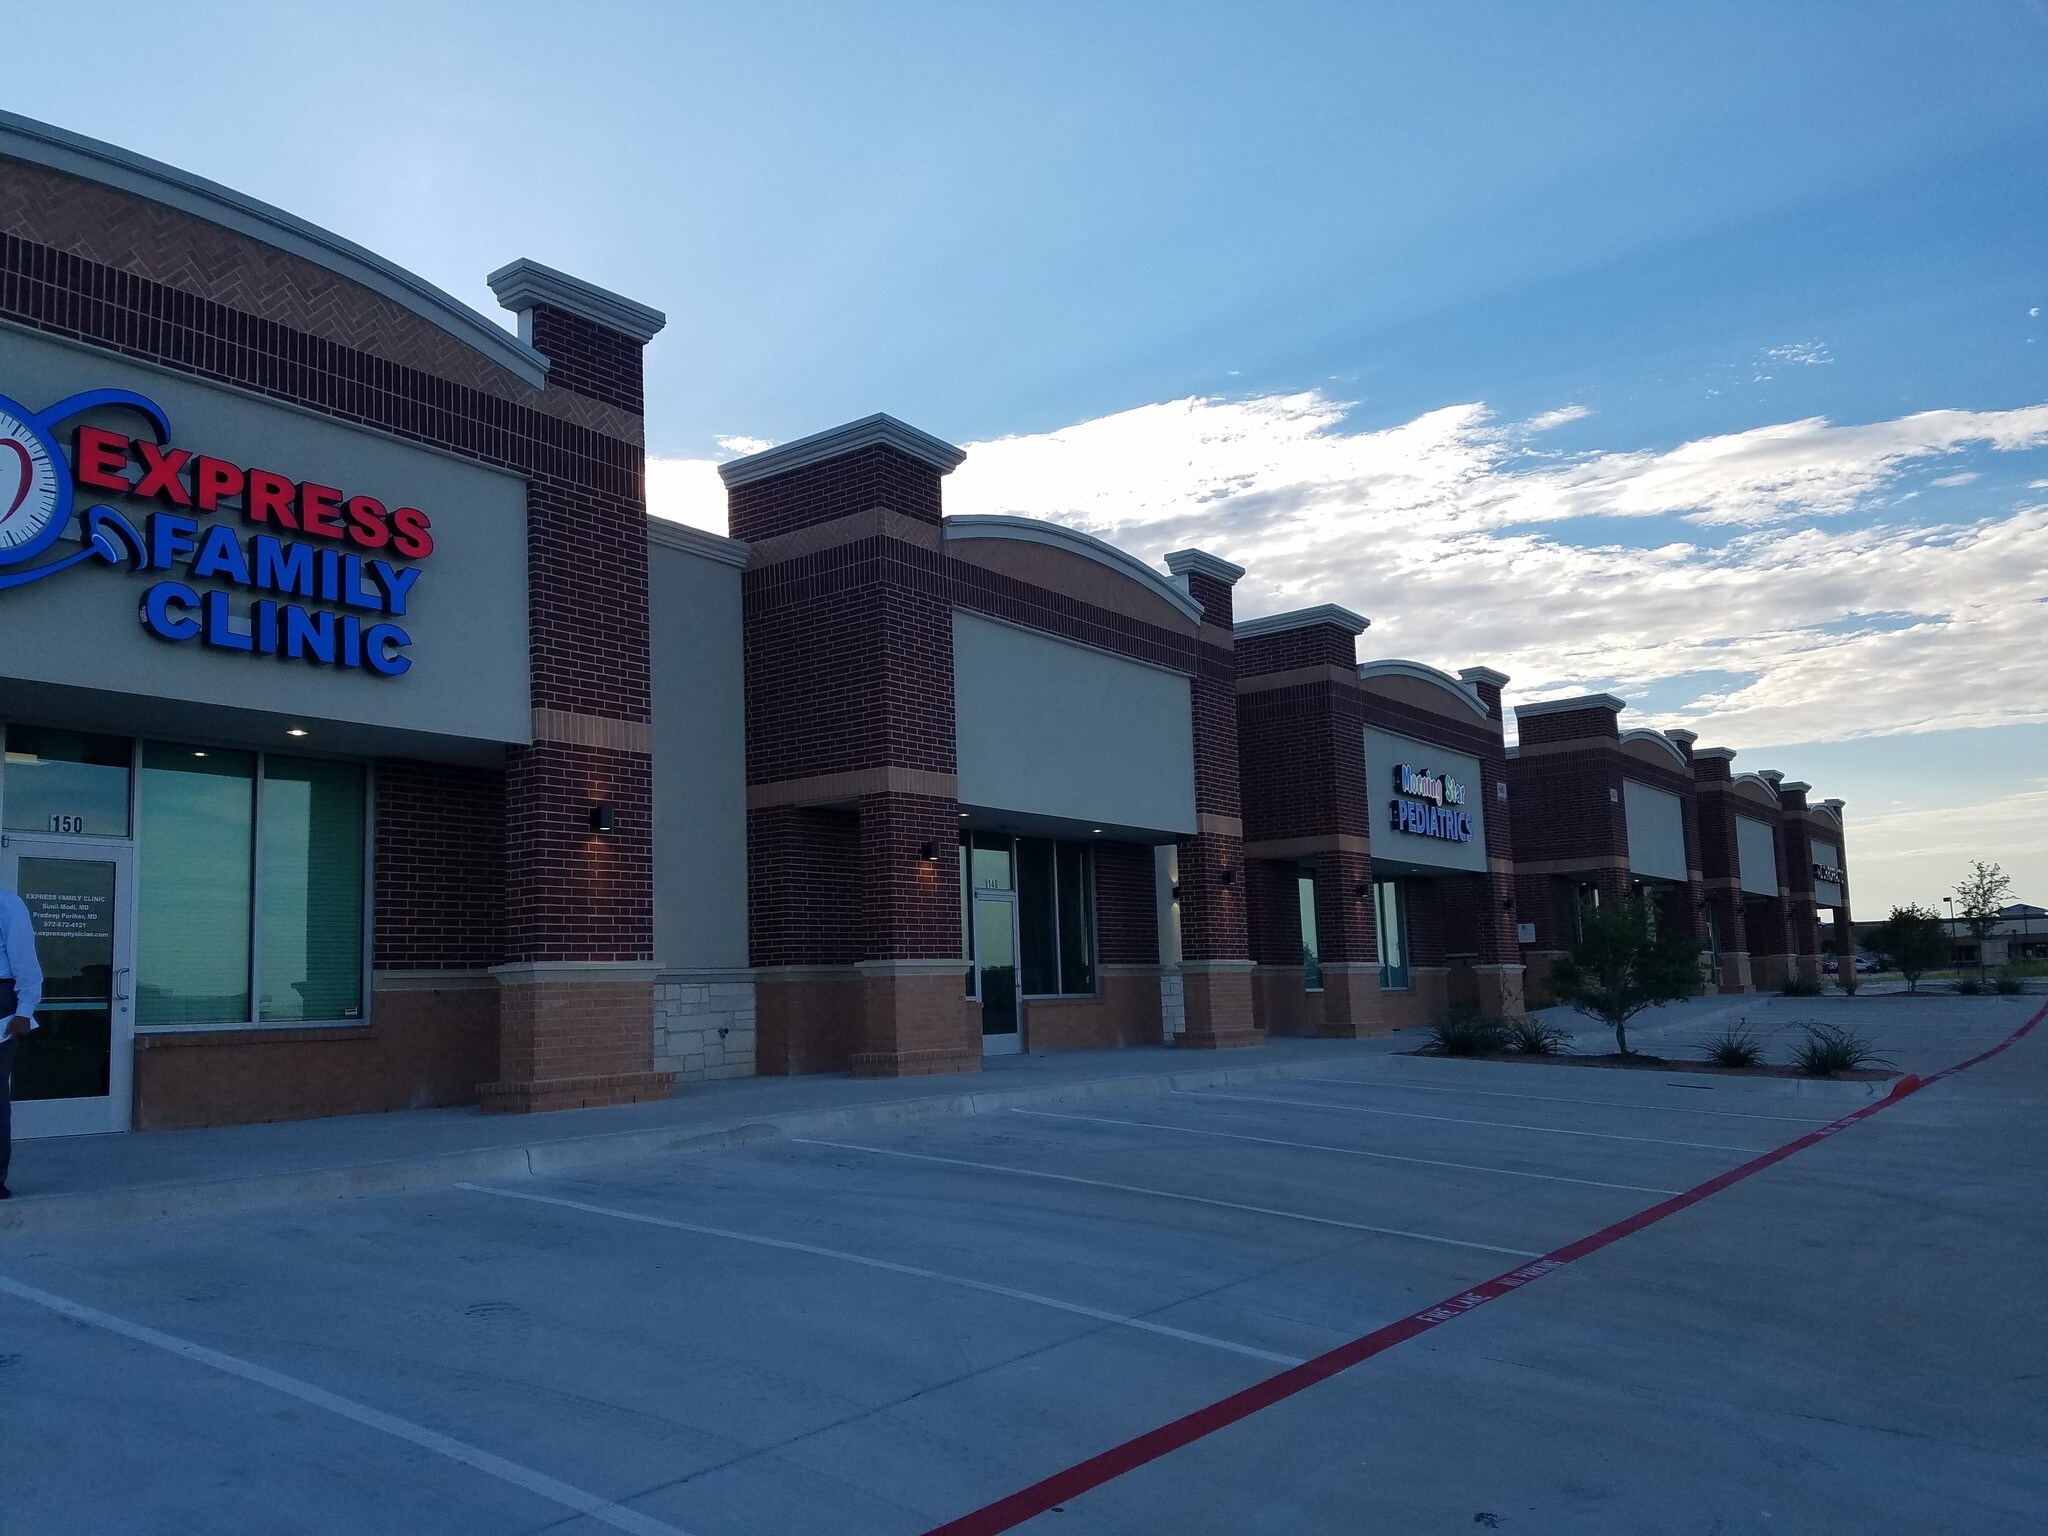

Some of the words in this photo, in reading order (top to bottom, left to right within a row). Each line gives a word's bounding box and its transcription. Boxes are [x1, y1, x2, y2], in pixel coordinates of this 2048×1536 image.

[75, 425, 433, 558] EXPRESS
[150, 513, 422, 616] FAMILY
[142, 581, 413, 676] CLINIC
[1401, 764, 1443, 806] Morning
[1444, 774, 1467, 805] Star
[52, 815, 83, 834] 150
[1398, 799, 1473, 842] PEDIATRICS
[26, 893, 57, 901] EXPRESS
[58, 894, 82, 902] FAMILY
